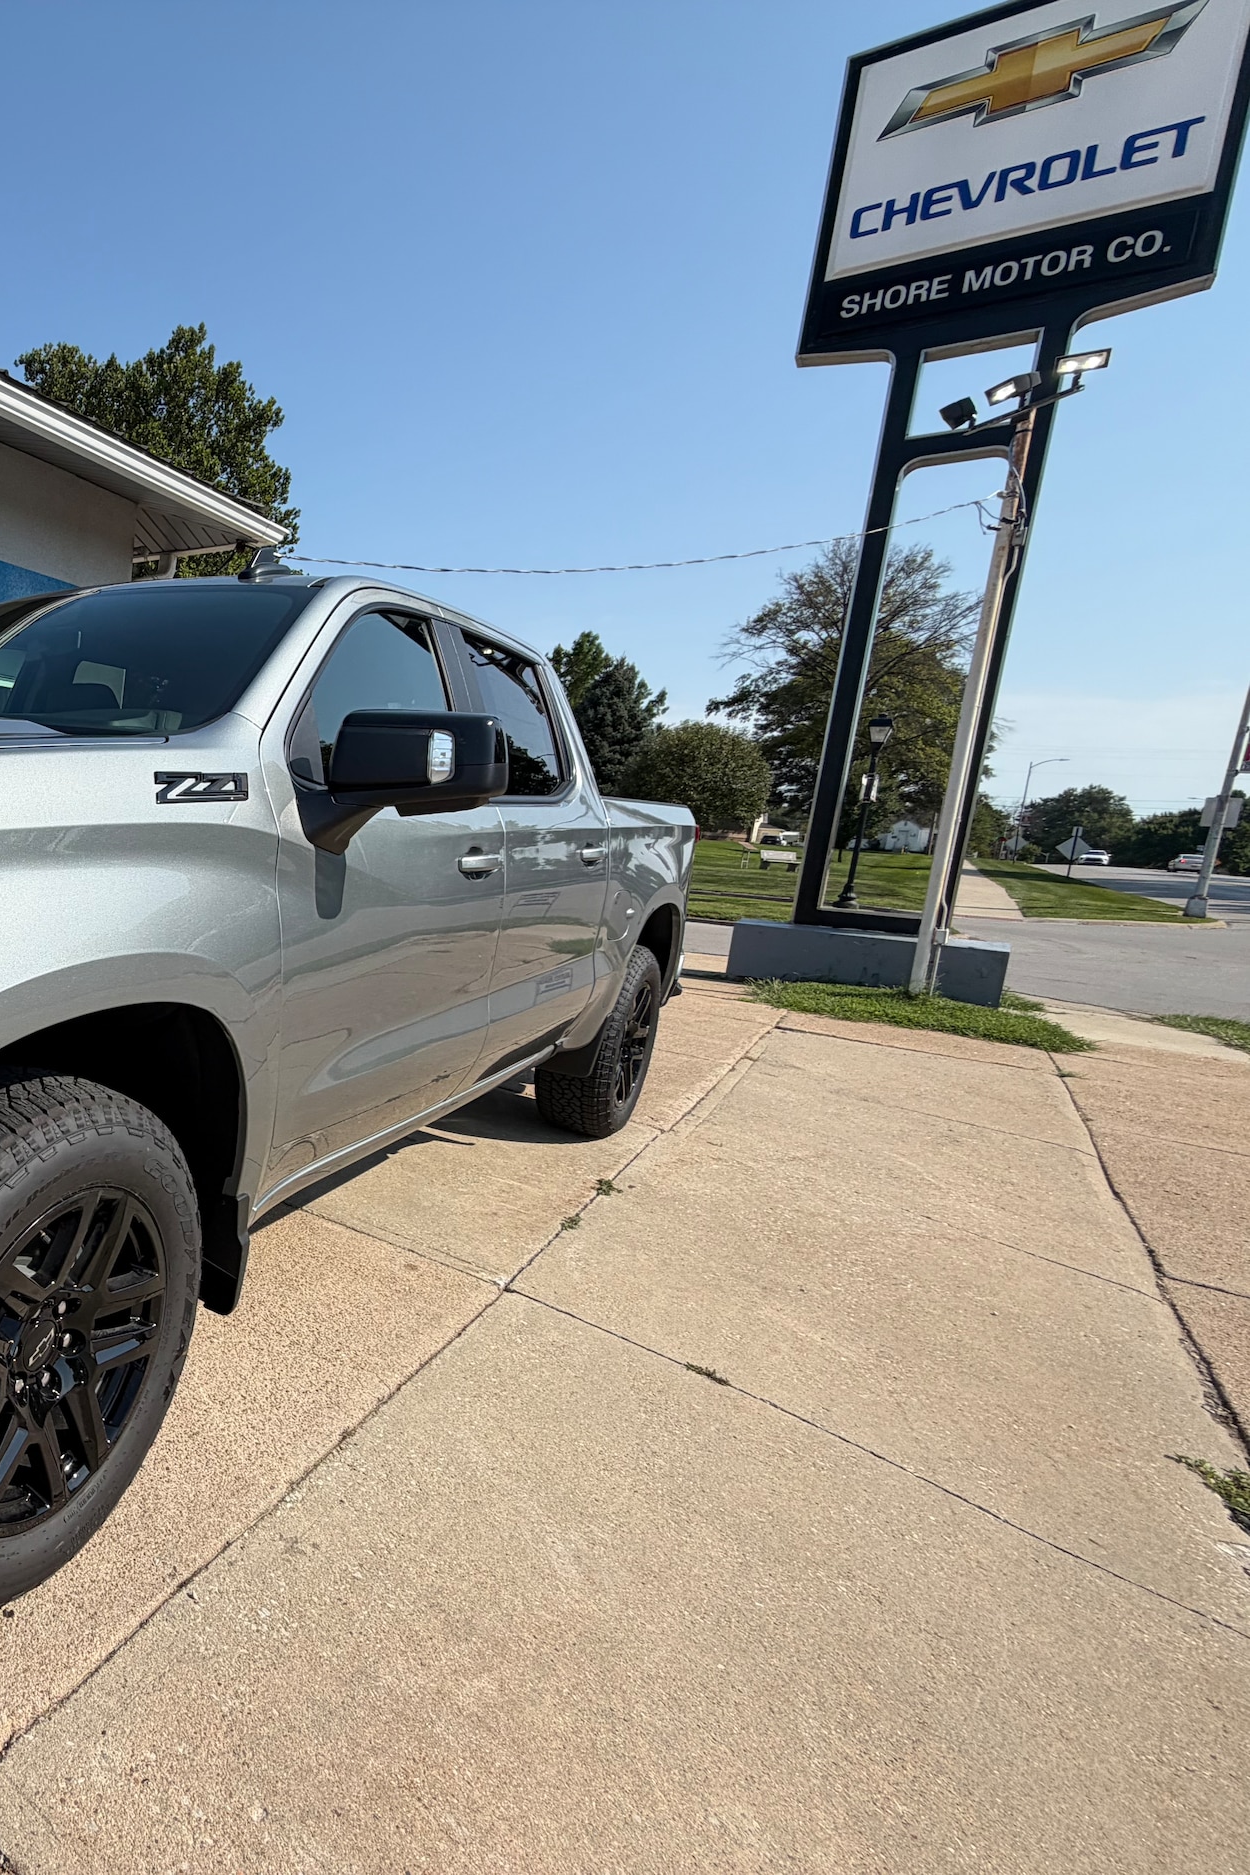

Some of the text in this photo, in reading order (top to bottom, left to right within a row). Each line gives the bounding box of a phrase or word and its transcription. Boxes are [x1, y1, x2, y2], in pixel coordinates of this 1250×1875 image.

[850, 116, 1206, 239] CHEVROLET
[840, 229, 1172, 319] SHORE MOTOR CO.
[154, 771, 248, 804] Z71
